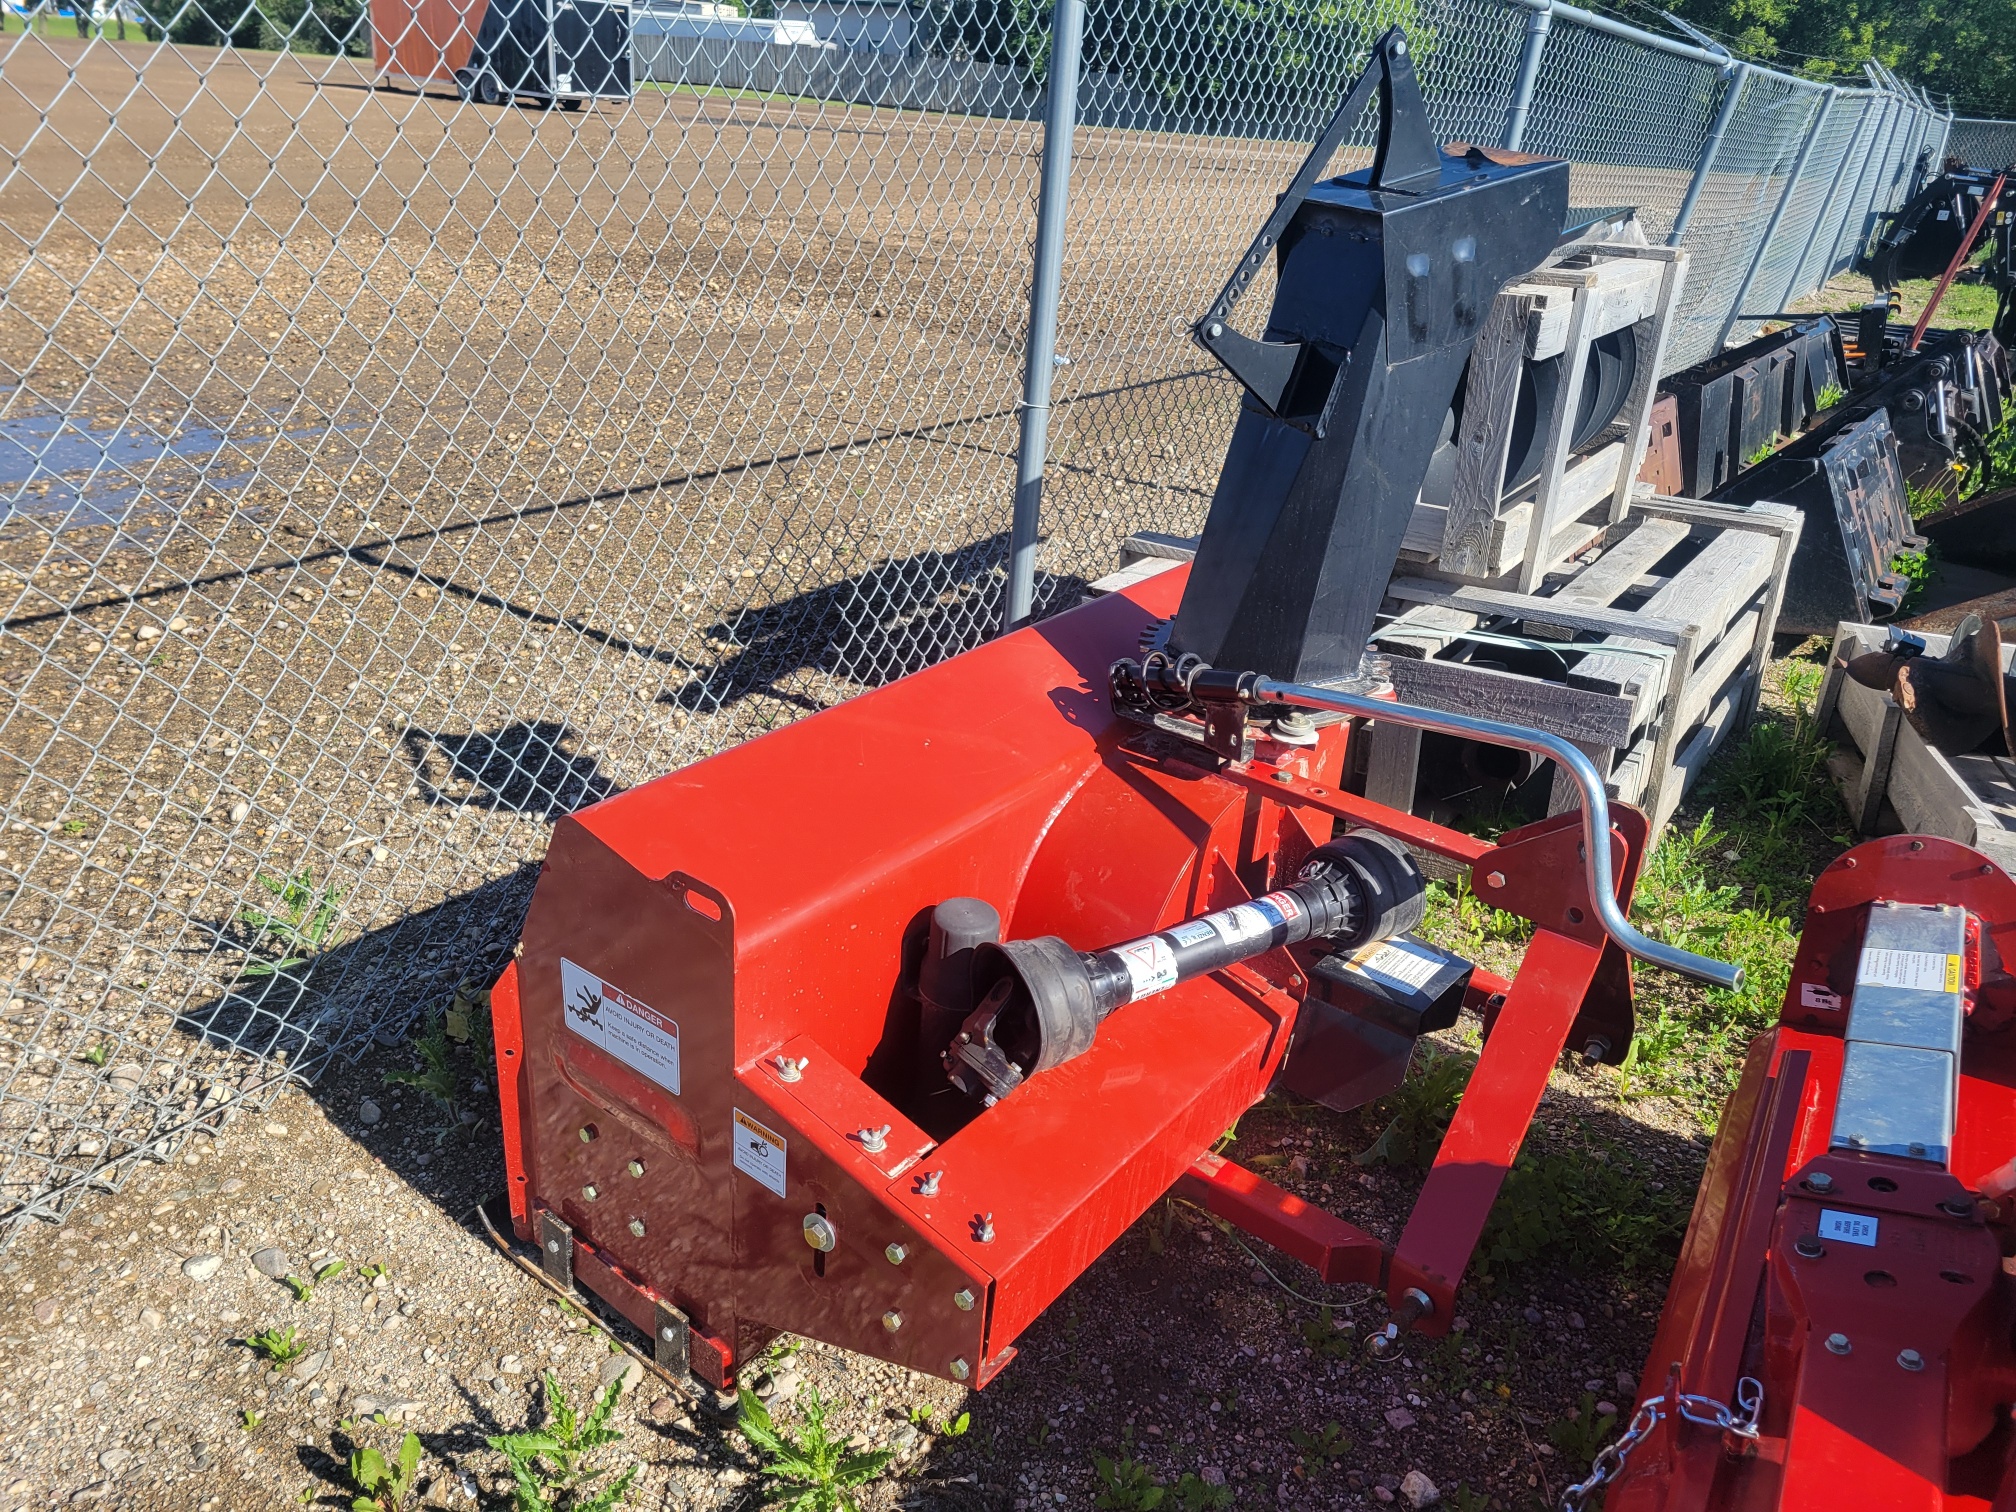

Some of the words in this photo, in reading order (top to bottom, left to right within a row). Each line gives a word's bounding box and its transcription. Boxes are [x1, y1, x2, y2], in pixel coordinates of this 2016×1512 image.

[1270, 893, 1294, 918] ANGER
[626, 1000, 662, 1027] DANGER
[606, 1006, 623, 1022] AVOID
[624, 1016, 644, 1035] INJURY
[646, 1029, 655, 1039] OR
[656, 1035, 675, 1052] DEATH
[607, 1022, 621, 1035] Keep
[626, 1032, 636, 1044] safe
[638, 1039, 659, 1056] distance
[660, 1053, 674, 1066] when
[608, 1030, 630, 1047] machine
[642, 1050, 667, 1069] operation.
[747, 1122, 780, 1147] WARNING
[1852, 1226, 1860, 1236] LEVEL
